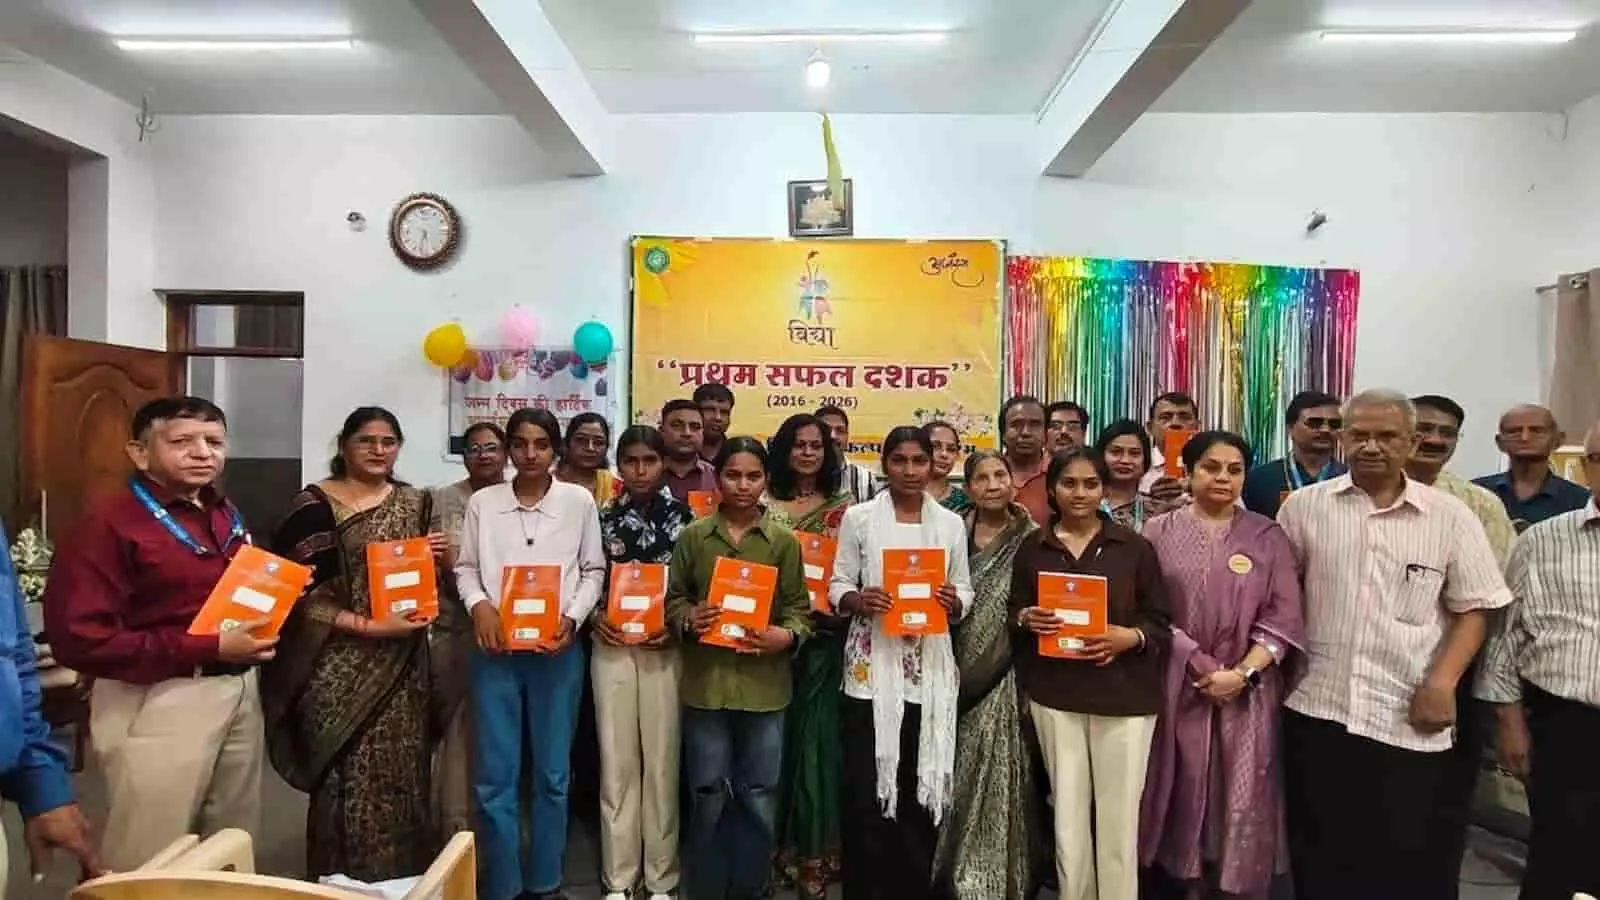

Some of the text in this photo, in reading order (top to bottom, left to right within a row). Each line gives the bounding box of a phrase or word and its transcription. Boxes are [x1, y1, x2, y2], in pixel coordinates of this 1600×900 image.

[787, 319, 840, 350] विद्या
[766, 365, 856, 387] सफल
[767, 395, 806, 409] (2016
[819, 396, 858, 409] 2026)
